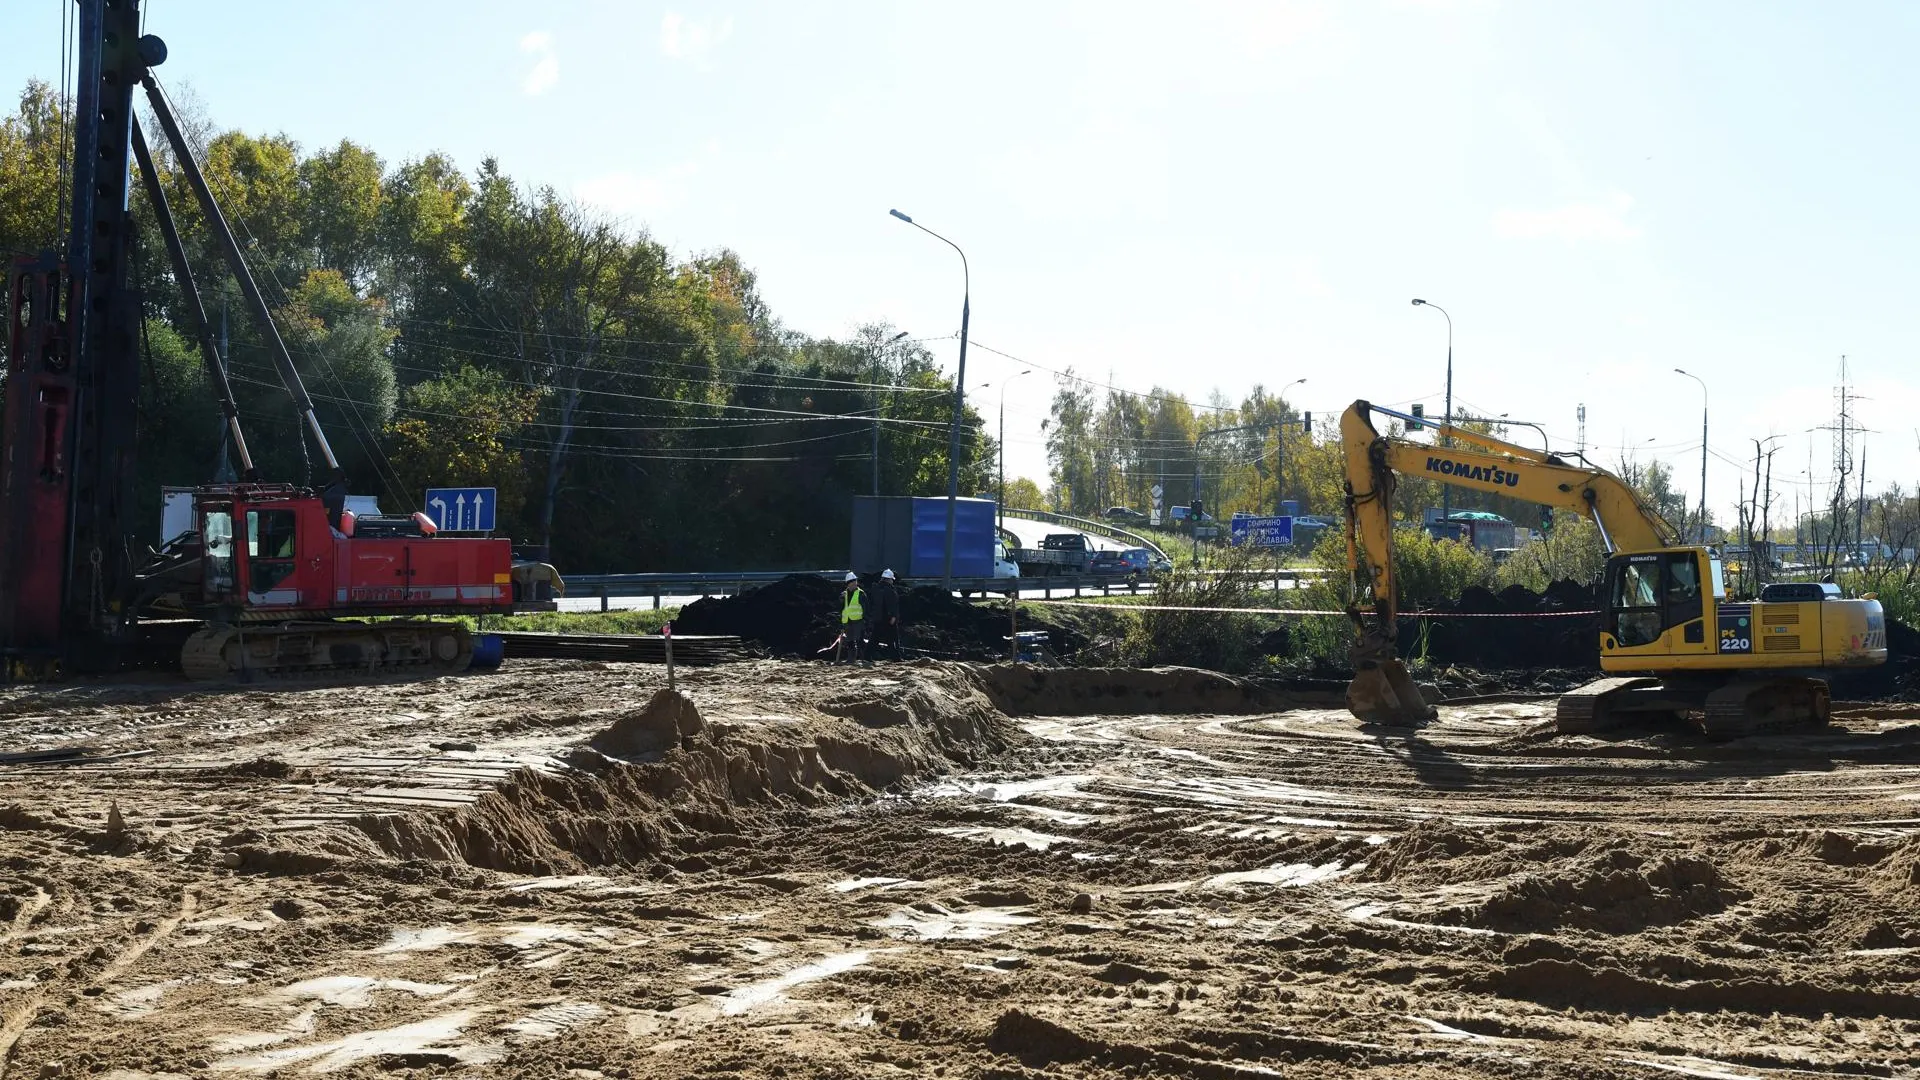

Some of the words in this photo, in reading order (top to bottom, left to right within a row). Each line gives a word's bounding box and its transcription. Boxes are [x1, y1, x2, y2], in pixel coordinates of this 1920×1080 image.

[1426, 457, 1519, 487] KOMATSU
[1247, 536, 1290, 544] РОСЛАВЛЬ
[1721, 629, 1736, 638] PC
[1721, 638, 1750, 650] 220
